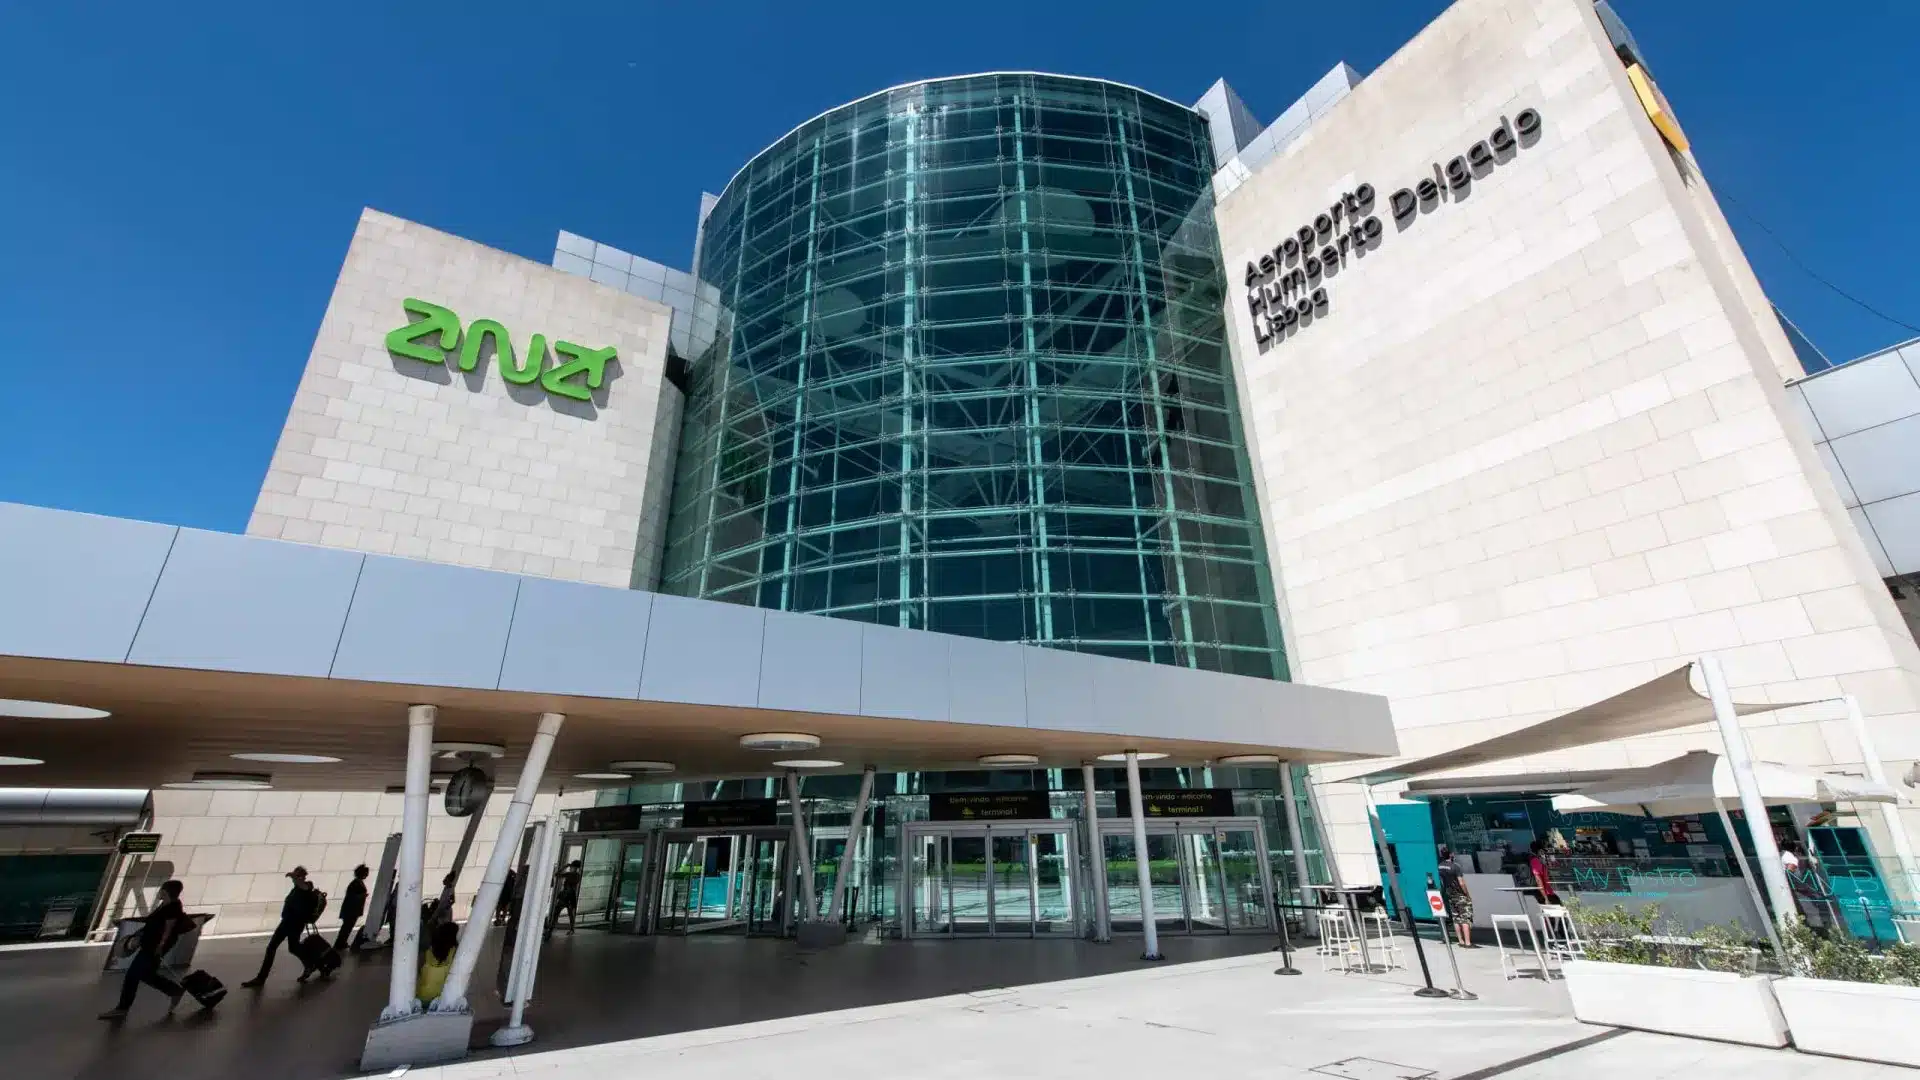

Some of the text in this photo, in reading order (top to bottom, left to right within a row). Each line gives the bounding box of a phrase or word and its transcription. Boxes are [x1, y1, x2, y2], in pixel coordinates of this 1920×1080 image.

[1245, 182, 1376, 288] Aeroporto
[1248, 107, 1541, 316] Humberto Delgado
[1254, 287, 1329, 350] Lisboa
[1168, 805, 1199, 814] terminal
[1573, 865, 1697, 890] My Bistro
